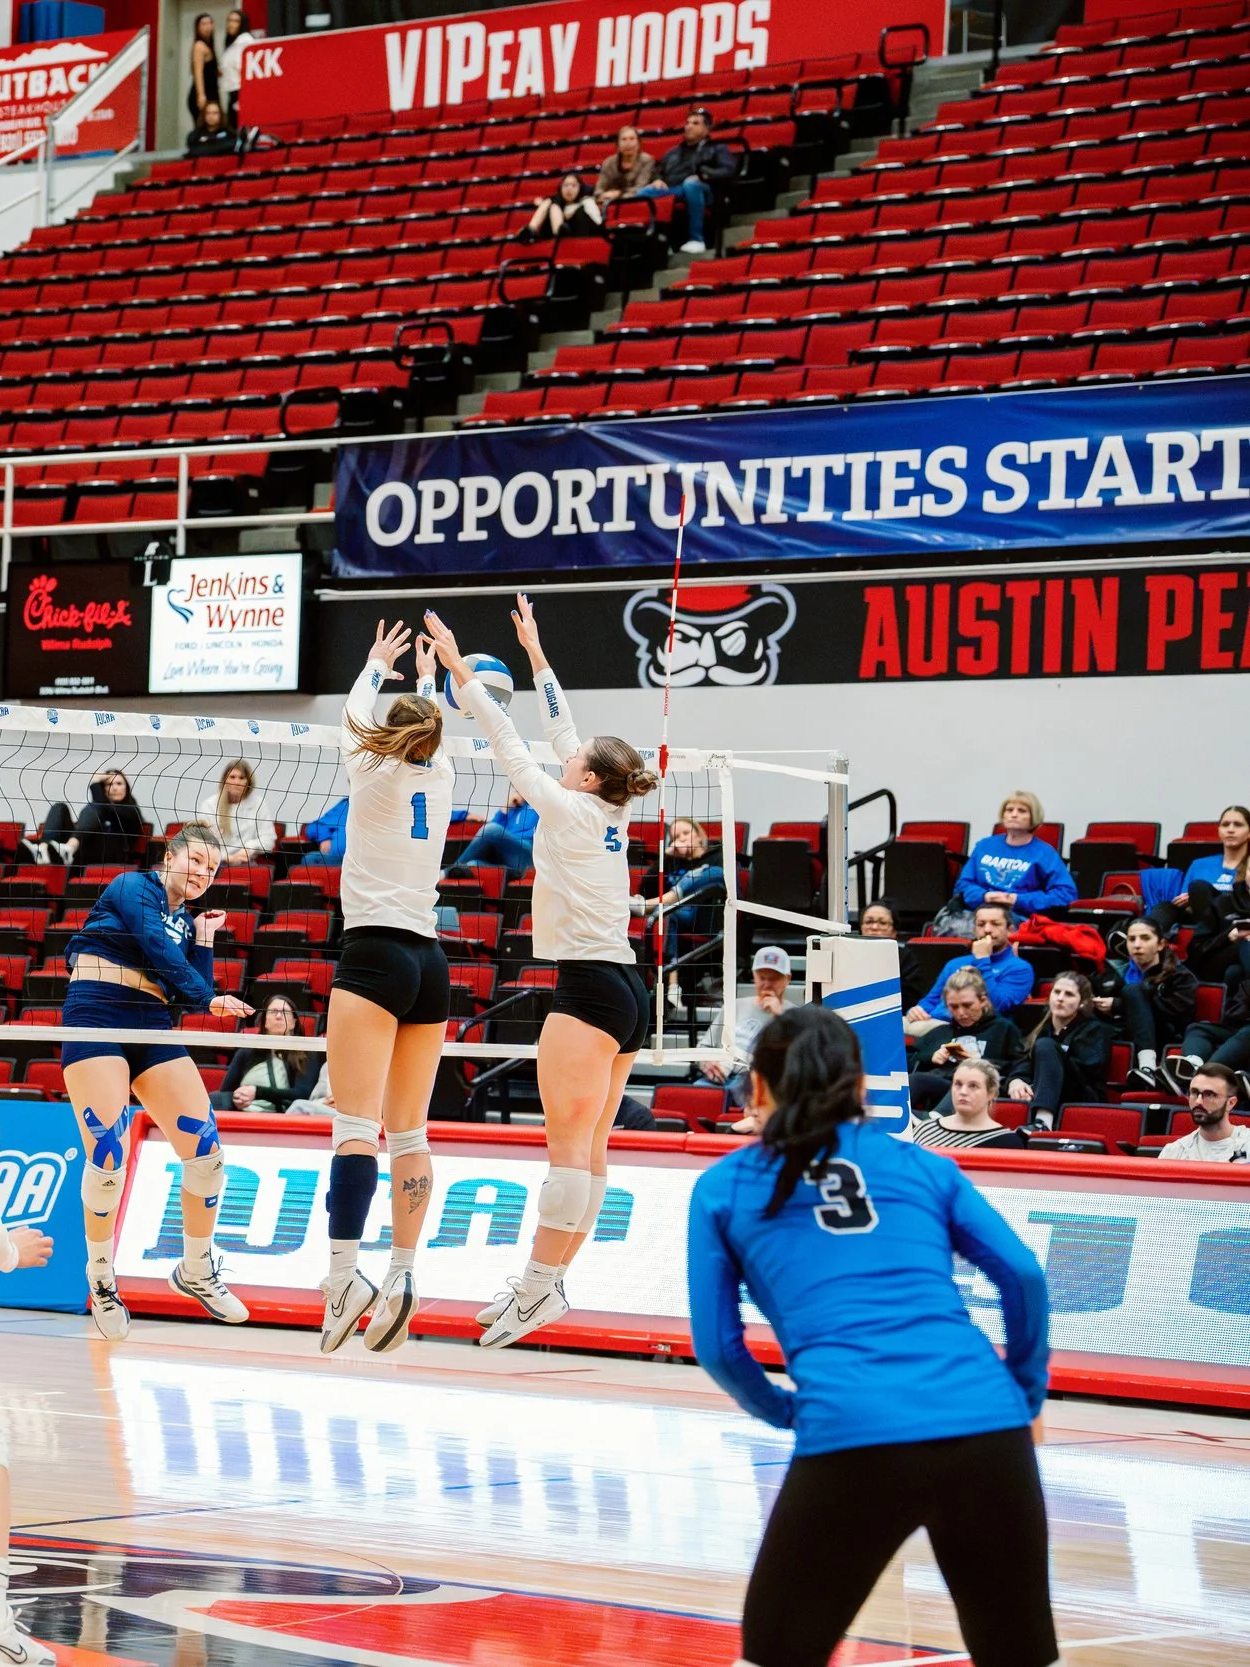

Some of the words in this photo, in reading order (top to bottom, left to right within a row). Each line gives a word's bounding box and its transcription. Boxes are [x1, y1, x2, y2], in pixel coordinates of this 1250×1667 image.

[595, 0, 771, 88] HOOPS
[245, 47, 284, 80] KK
[365, 445, 968, 547] OPPORTUNITIES
[982, 426, 1250, 514] START
[185, 571, 269, 602] Jenkins
[272, 574, 285, 594] &
[206, 604, 284, 632] Wynne
[858, 576, 1120, 679] AUSTIN
[1144, 571, 1250, 672] PE
[543, 682, 560, 718] COUGARS
[411, 792, 429, 839] 1
[604, 825, 622, 852] 5
[980, 854, 1031, 872] BARTON
[806, 1158, 879, 1236] 3
